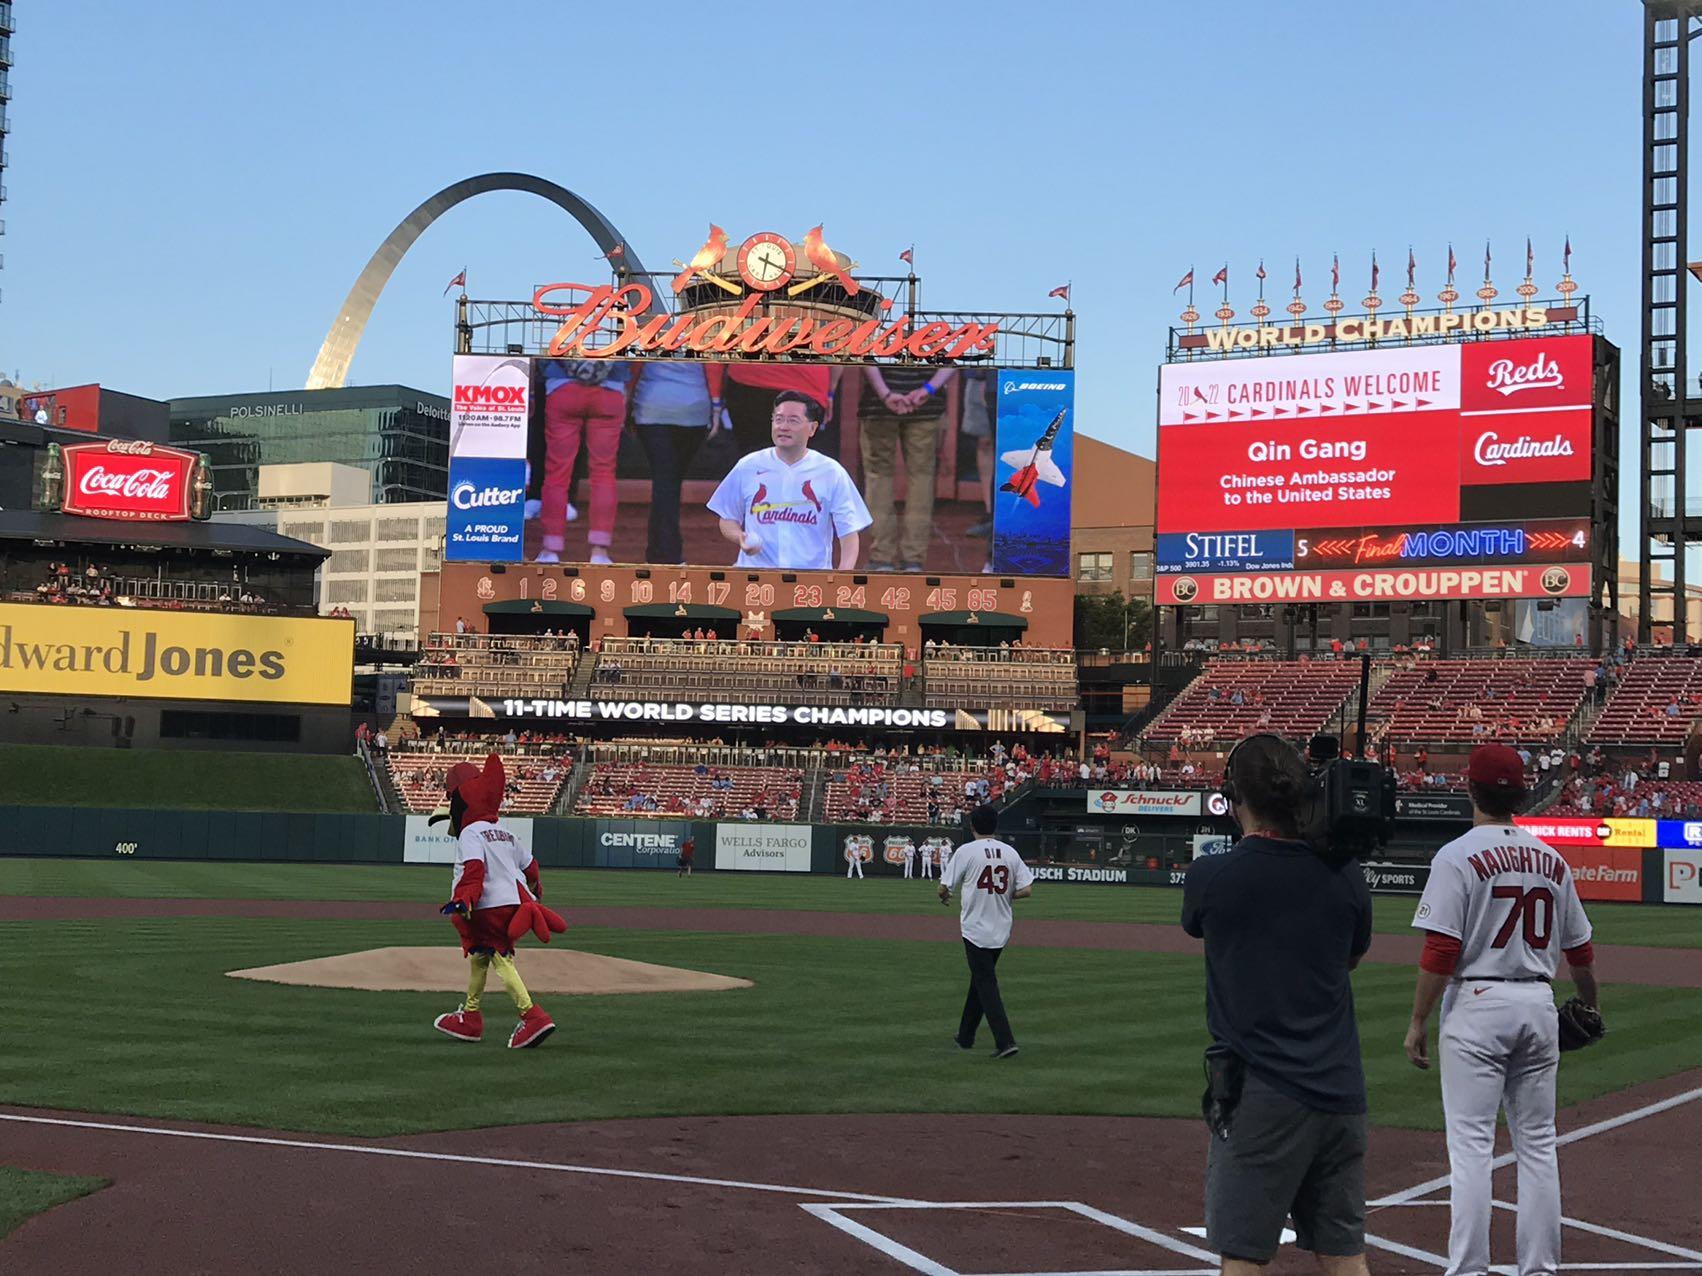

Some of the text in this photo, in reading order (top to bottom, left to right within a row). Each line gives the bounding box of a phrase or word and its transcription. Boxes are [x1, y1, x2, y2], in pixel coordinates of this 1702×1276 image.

[532, 282, 999, 358] Budweiser
[1206, 308, 1548, 351] WORLD CHAMPIONS
[1486, 352, 1564, 396] Reds
[455, 385, 526, 404] KMOX
[1019, 382, 1066, 391] BOEING
[1227, 377, 1335, 404] CARDINALS
[1344, 370, 1441, 397] WELCOME
[230, 404, 303, 418] POLSINELLI
[1248, 439, 1367, 462] Qin Gang
[1474, 431, 1574, 466] Cardinals
[80, 466, 175, 499] Coca-Cola
[1220, 468, 1395, 489] Chinese Ambassador
[453, 484, 523, 510] Cutter
[1224, 485, 1391, 505] to the United States
[86, 508, 168, 520] ROOFTOP DECK
[452, 533, 519, 543] St. Louis Brand
[464, 524, 508, 533] A PROUD
[1185, 532, 1264, 559] STIFEL
[1354, 533, 1405, 564] Final
[1400, 528, 1523, 557] MONTH
[1572, 530, 1585, 548] 4
[520, 577, 528, 599] 1
[542, 578, 557, 600] 2
[571, 579, 585, 601] 6
[600, 579, 616, 602] 9
[631, 580, 653, 603] 10
[668, 581, 692, 604] 14
[707, 582, 731, 605] 17
[745, 583, 775, 606] 20
[793, 585, 822, 608] 23
[836, 585, 865, 609] 24
[881, 587, 911, 610] 42
[926, 588, 956, 611] 45
[968, 588, 997, 612] 85
[1213, 576, 1322, 600] BROWN
[1329, 580, 1347, 597] &
[1354, 570, 1523, 597] CROUPPEN
[0, 625, 286, 681] dward Jones
[503, 699, 946, 727] 11-TIME WORLD SERIES CHAMPIONS
[1120, 793, 1194, 806] Schnucks
[601, 832, 676, 849] CENTENE
[721, 836, 808, 848] WELLS FARGO
[1519, 825, 1556, 838] ABICK
[1558, 825, 1593, 838] RENTS
[115, 842, 138, 855] 400'
[743, 848, 785, 858] Advisors
[1030, 867, 1127, 882] USCH STADIUM
[1467, 845, 1565, 886] NAUGHTON
[977, 865, 1009, 895] 43
[1382, 874, 1415, 885] SPORTS
[1490, 885, 1554, 950] 70
